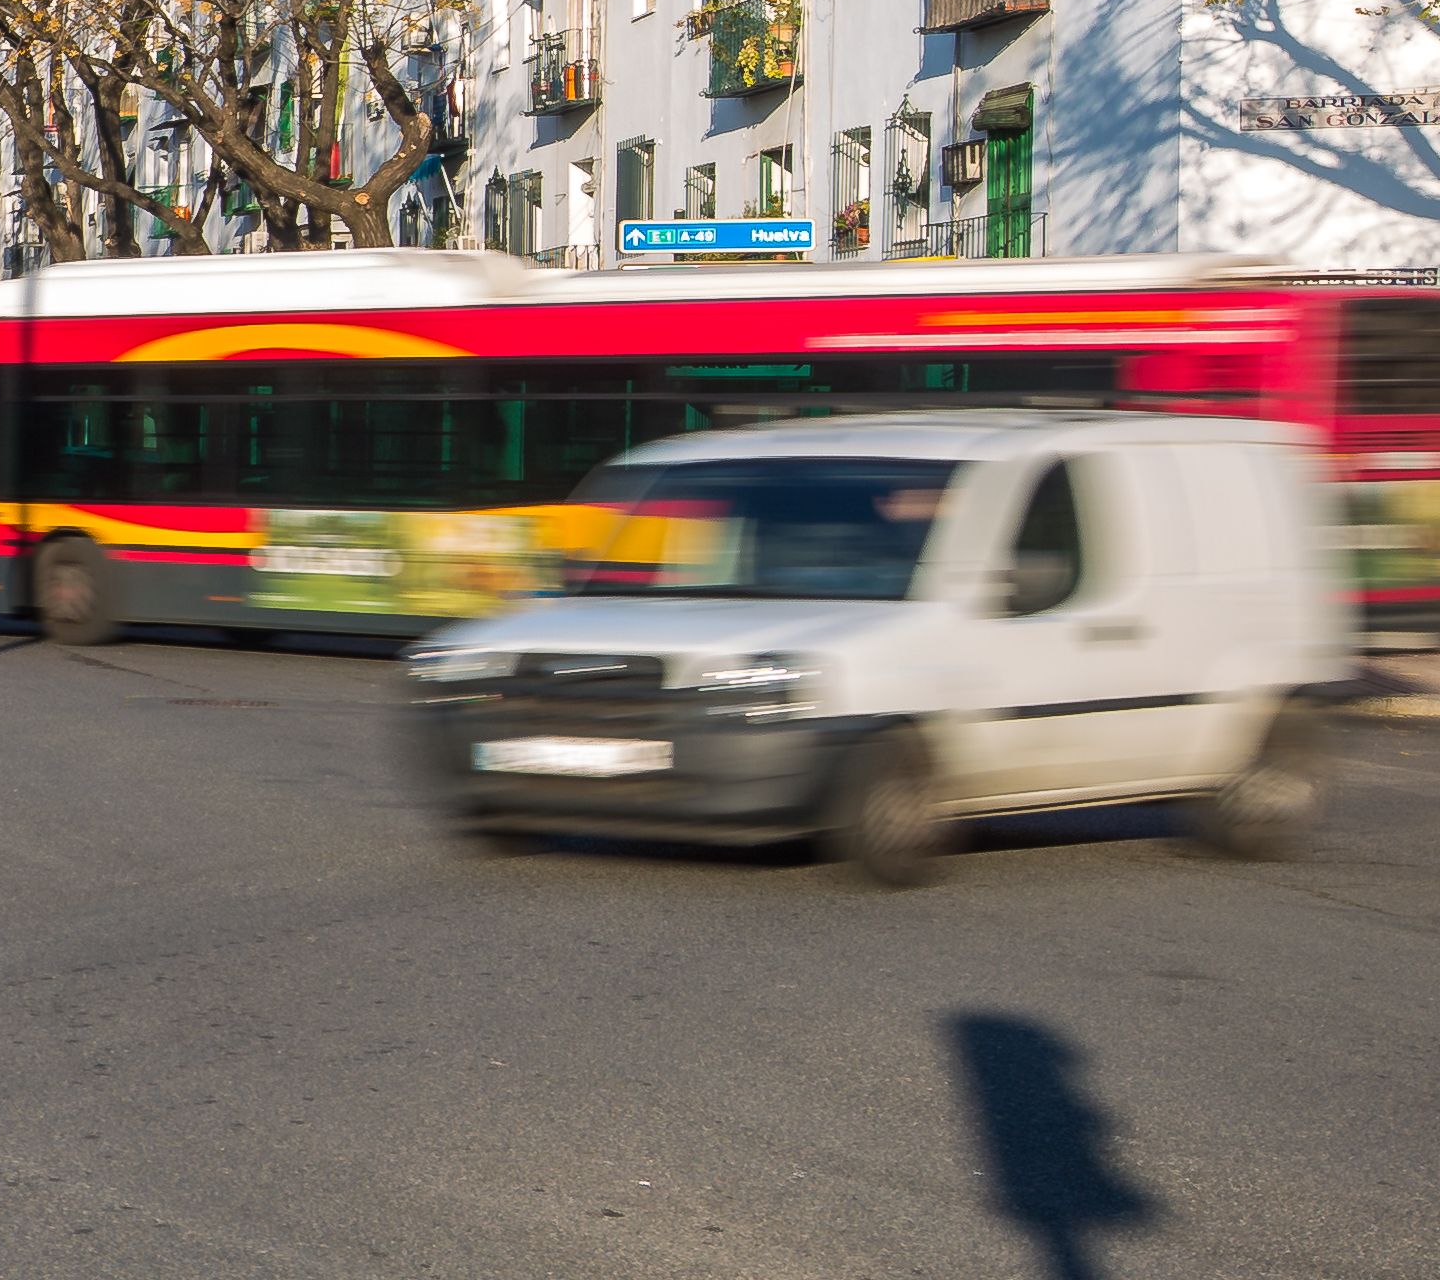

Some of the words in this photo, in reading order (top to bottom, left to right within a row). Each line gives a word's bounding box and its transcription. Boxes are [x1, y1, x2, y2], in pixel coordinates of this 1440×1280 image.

[1285, 96, 1424, 109] BARRIADA
[1256, 115, 1312, 128] SAN
[652, 231, 672, 243] E-1
[680, 230, 714, 242] A-49
[751, 228, 810, 243] Huelva
